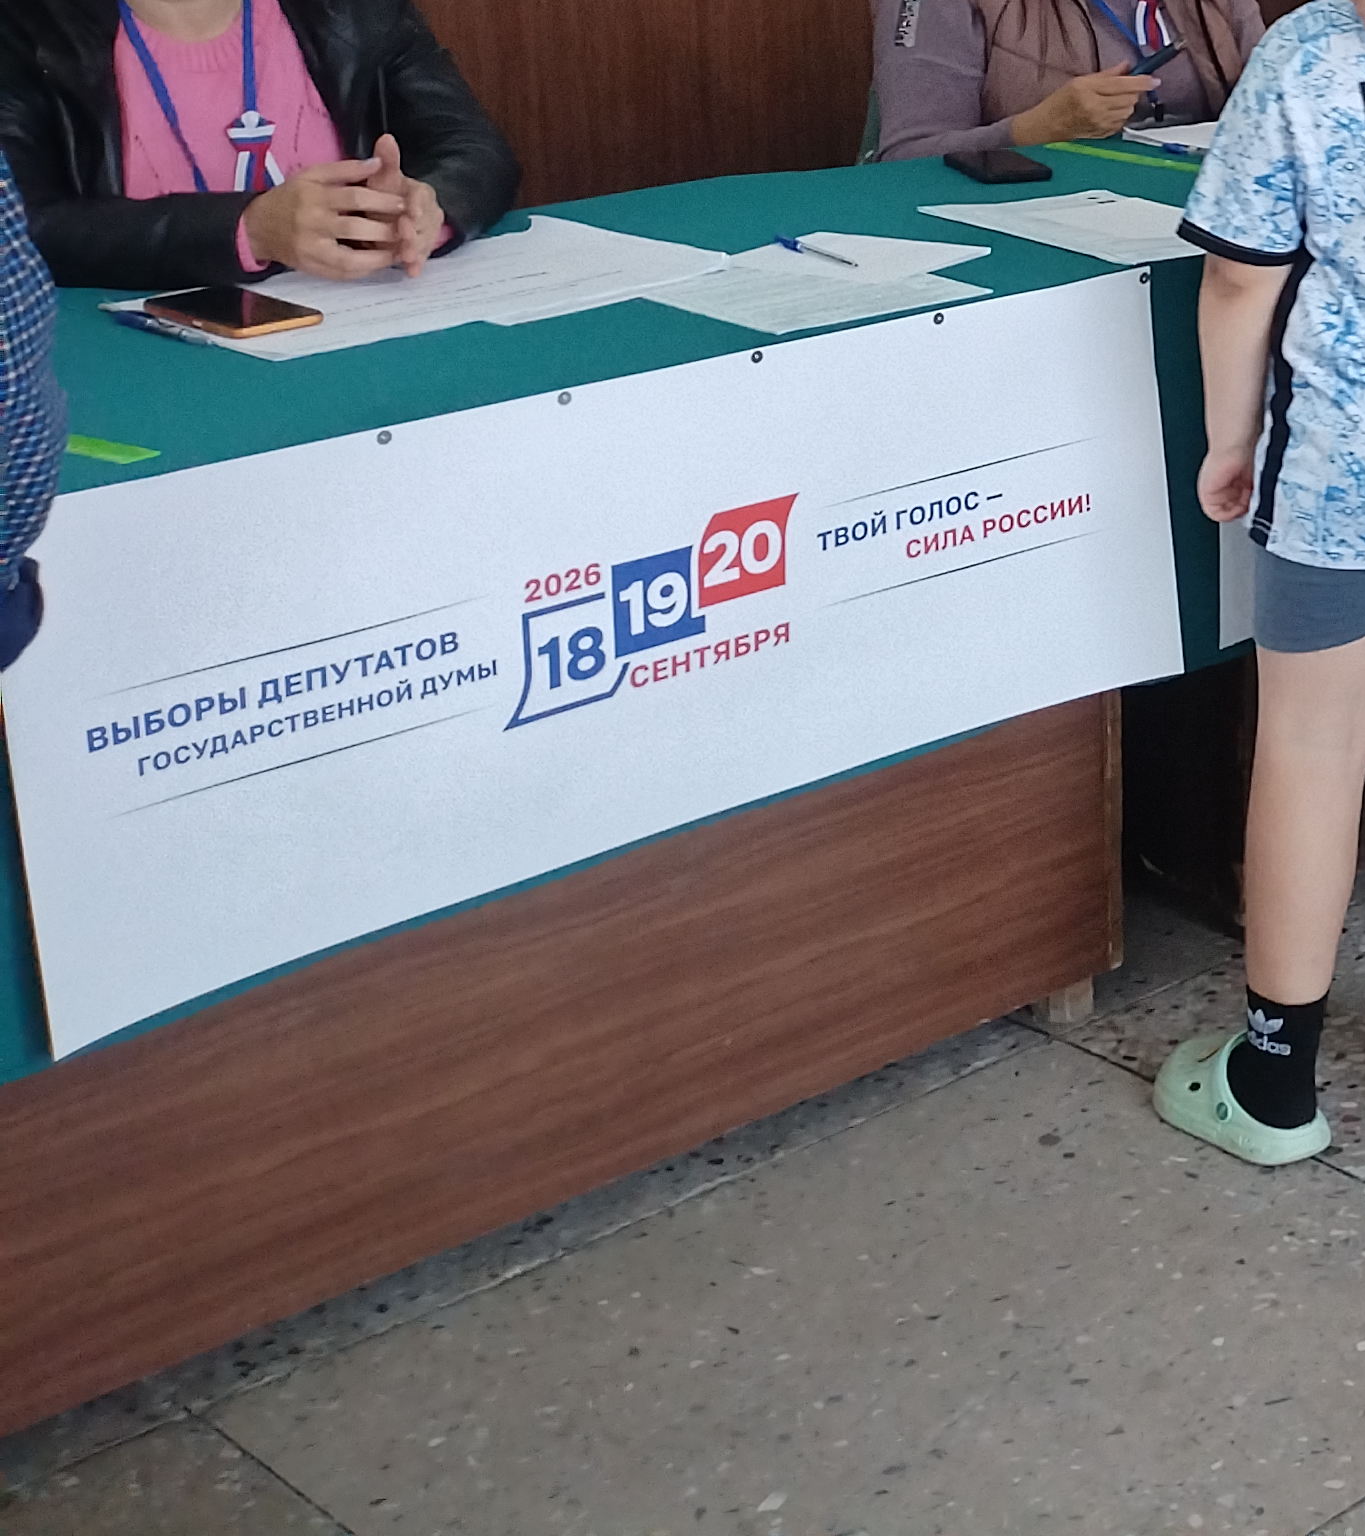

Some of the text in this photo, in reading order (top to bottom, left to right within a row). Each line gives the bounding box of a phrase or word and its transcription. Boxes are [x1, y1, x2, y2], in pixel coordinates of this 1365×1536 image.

[816, 510, 888, 552] ТВОЙ
[895, 490, 981, 531] ГОЛОС
[906, 493, 1092, 559] СИЛА РОССИИ!
[524, 563, 602, 605] 2026
[536, 519, 783, 690] 18 19 20
[630, 621, 791, 689] СЕНТЯБРЯ
[86, 630, 460, 754] ВЫБОРЫ ДЕПУТАТОВ
[137, 659, 498, 777] ГОСУДАРСТВЕННОЙ ДУМЫ
